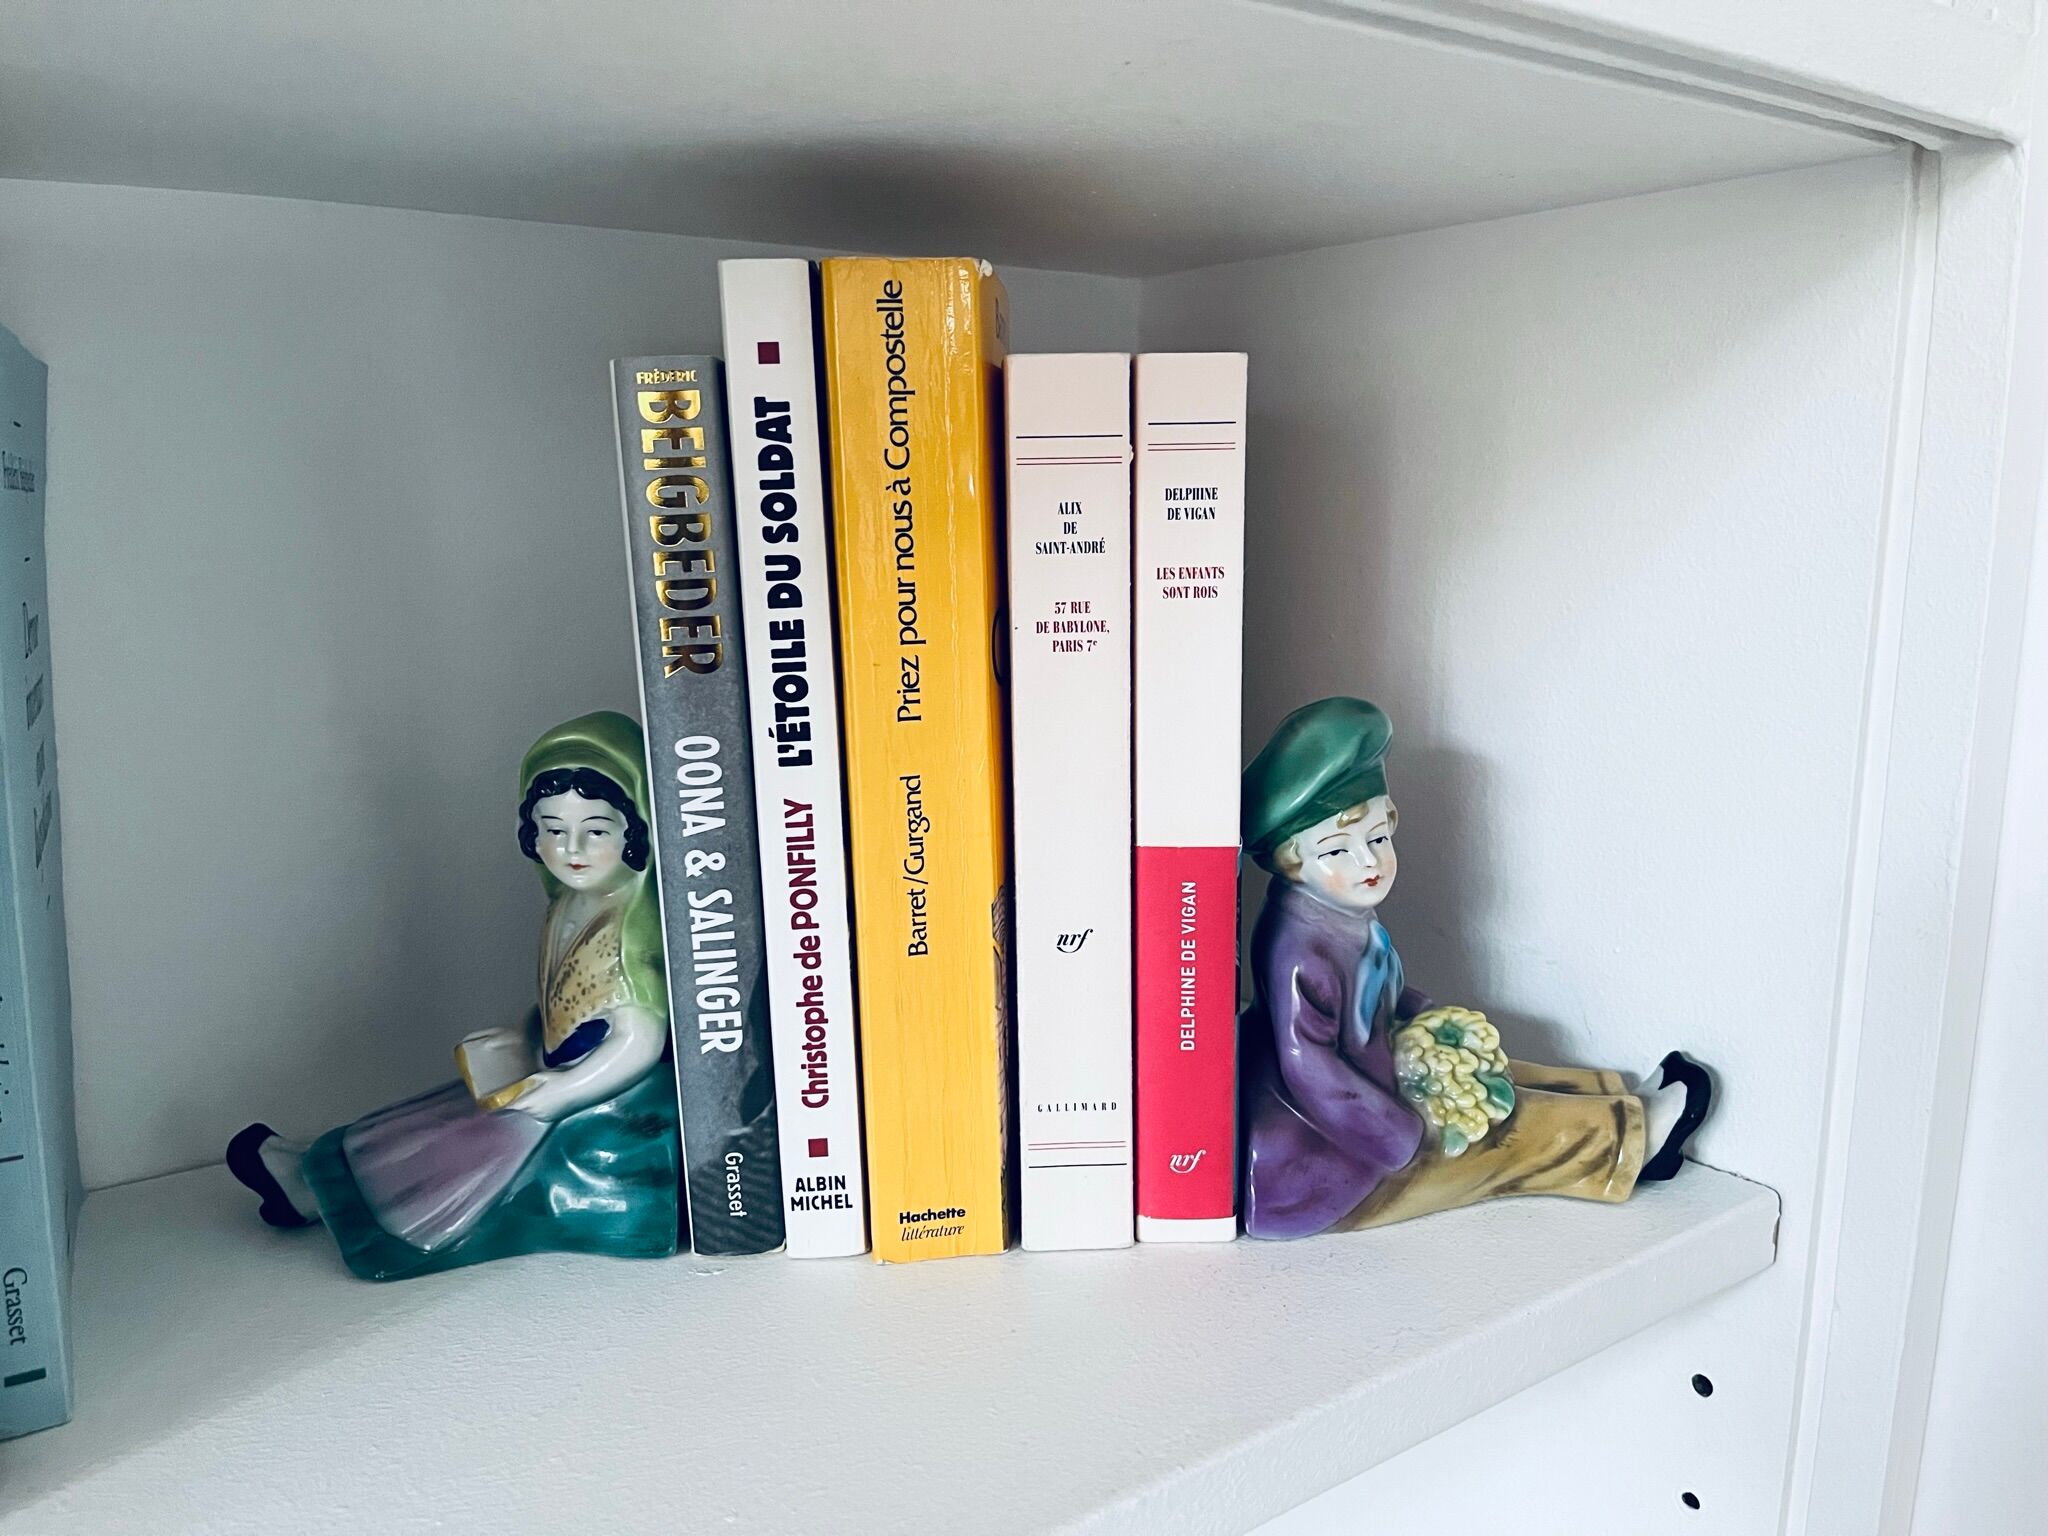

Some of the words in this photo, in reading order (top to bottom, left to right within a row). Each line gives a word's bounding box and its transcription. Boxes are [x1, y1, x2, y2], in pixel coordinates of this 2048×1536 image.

[876, 279, 916, 471] Compostelle
[754, 396, 799, 544] SOLDAT
[886, 477, 912, 495] à
[1164, 487, 1219, 501] DELPHINE
[1057, 501, 1083, 515] ALIX
[1167, 507, 1181, 521] DE
[1184, 506, 1216, 521] VIGAN
[637, 389, 723, 680] BEIGBEDER
[894, 500, 916, 570] nous
[1063, 521, 1078, 535] DE
[1035, 537, 1106, 555] SAINT-ANDRÉ
[764, 553, 803, 610] DU
[1156, 567, 1176, 580] LES
[1178, 566, 1225, 580] ENFANTS
[1162, 586, 1190, 600] SONT
[1193, 586, 1218, 599] ROIS
[898, 577, 926, 645] pour
[1054, 601, 1067, 615] 57
[1070, 601, 1091, 615] RUE
[1036, 621, 1050, 634] DE
[1053, 620, 1110, 634] BABYLONE,
[1052, 639, 1084, 653] PARIS
[768, 618, 813, 768] L'ÉTOILE
[897, 653, 922, 723] Priez
[675, 735, 726, 839] OONA
[684, 850, 726, 878] &
[783, 798, 819, 931] PONFILLY
[1180, 881, 1197, 934] VIGAN
[794, 935, 822, 969] de
[1056, 928, 1093, 953] nrf
[1180, 939, 1196, 962] DE
[687, 888, 744, 1056] SALINGER
[1180, 966, 1196, 1051] DELPHINE
[796, 974, 830, 1109] Christophe
[1037, 1102, 1118, 1113] GALLIMARD
[1169, 1149, 1206, 1173] nrf
[724, 1152, 748, 1219] Grasset
[795, 1174, 847, 1193] ALBIN
[790, 1192, 853, 1212] MICHEL
[899, 1207, 966, 1225] Hachette
[900, 1221, 966, 1241] littérature
[3, 1267, 28, 1346] Grasset
